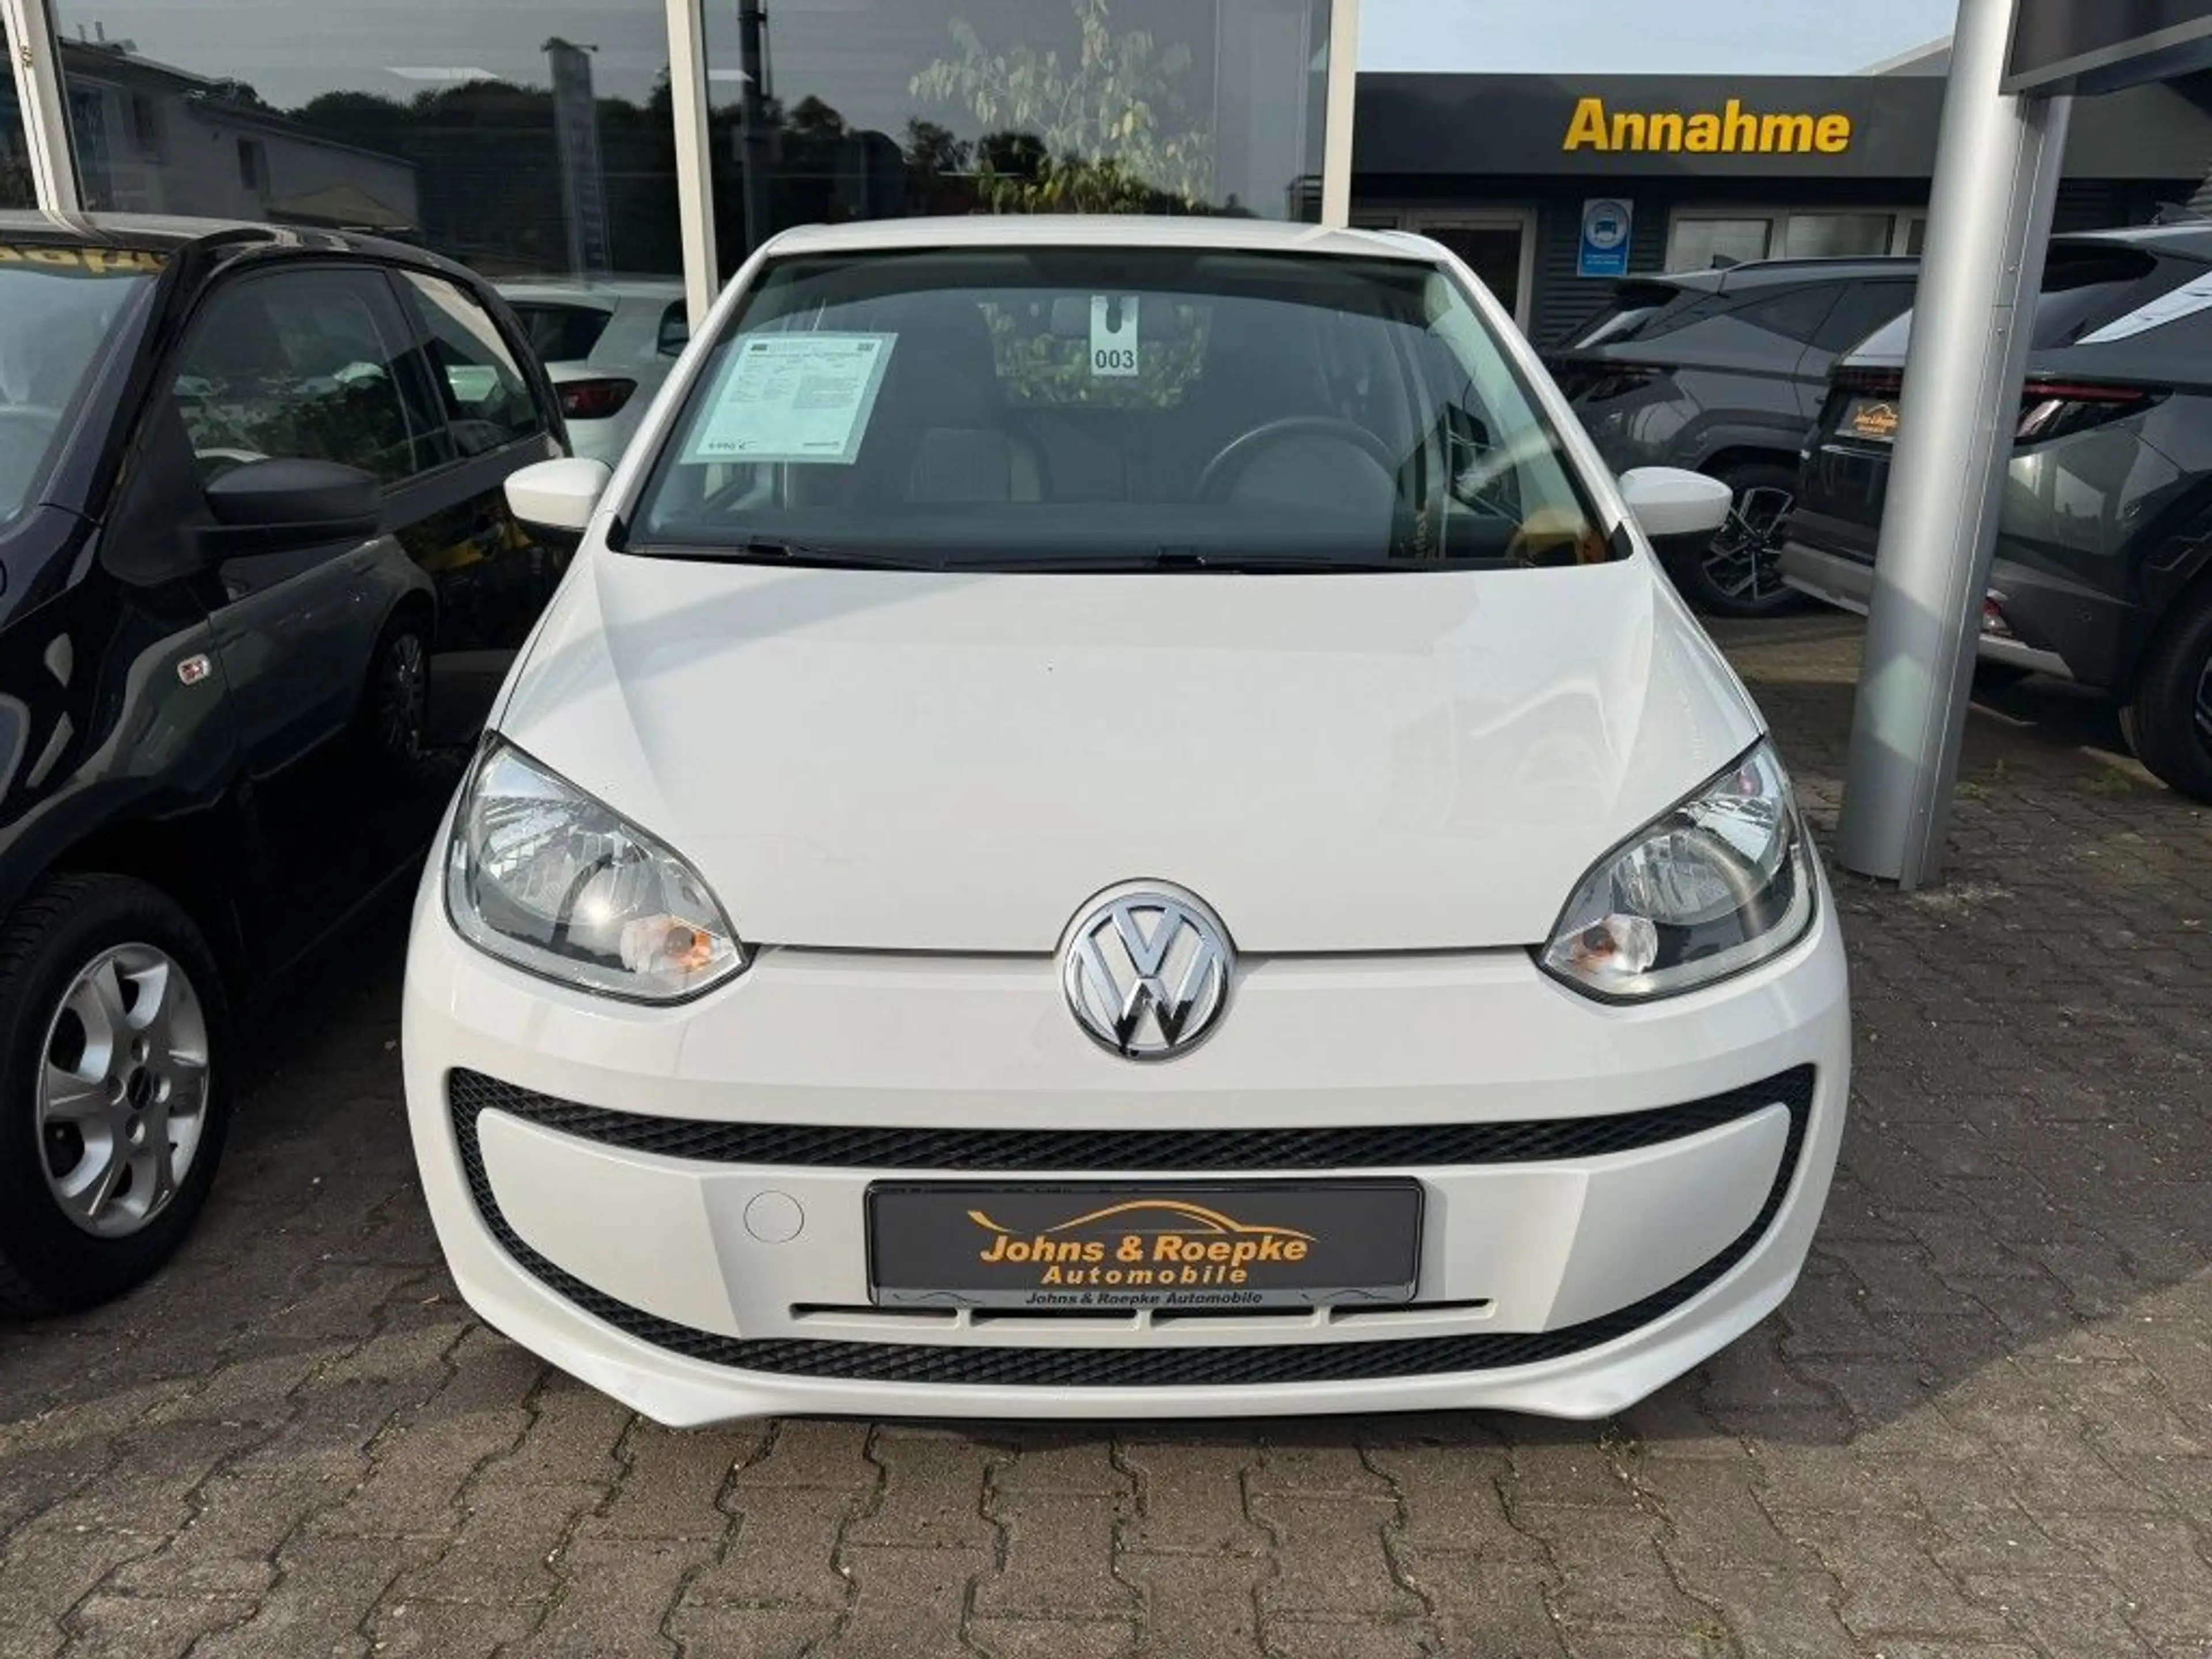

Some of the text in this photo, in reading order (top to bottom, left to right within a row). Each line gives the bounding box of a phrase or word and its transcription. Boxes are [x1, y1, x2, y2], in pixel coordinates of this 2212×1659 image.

[1562, 96, 1851, 154] Annahme
[1094, 349, 1135, 369] 003
[981, 1234, 1309, 1267] Johns & Roepke
[1041, 1265, 1249, 1285] Automobile
[1026, 1291, 1263, 1306] Johns & Roepke Automobile
